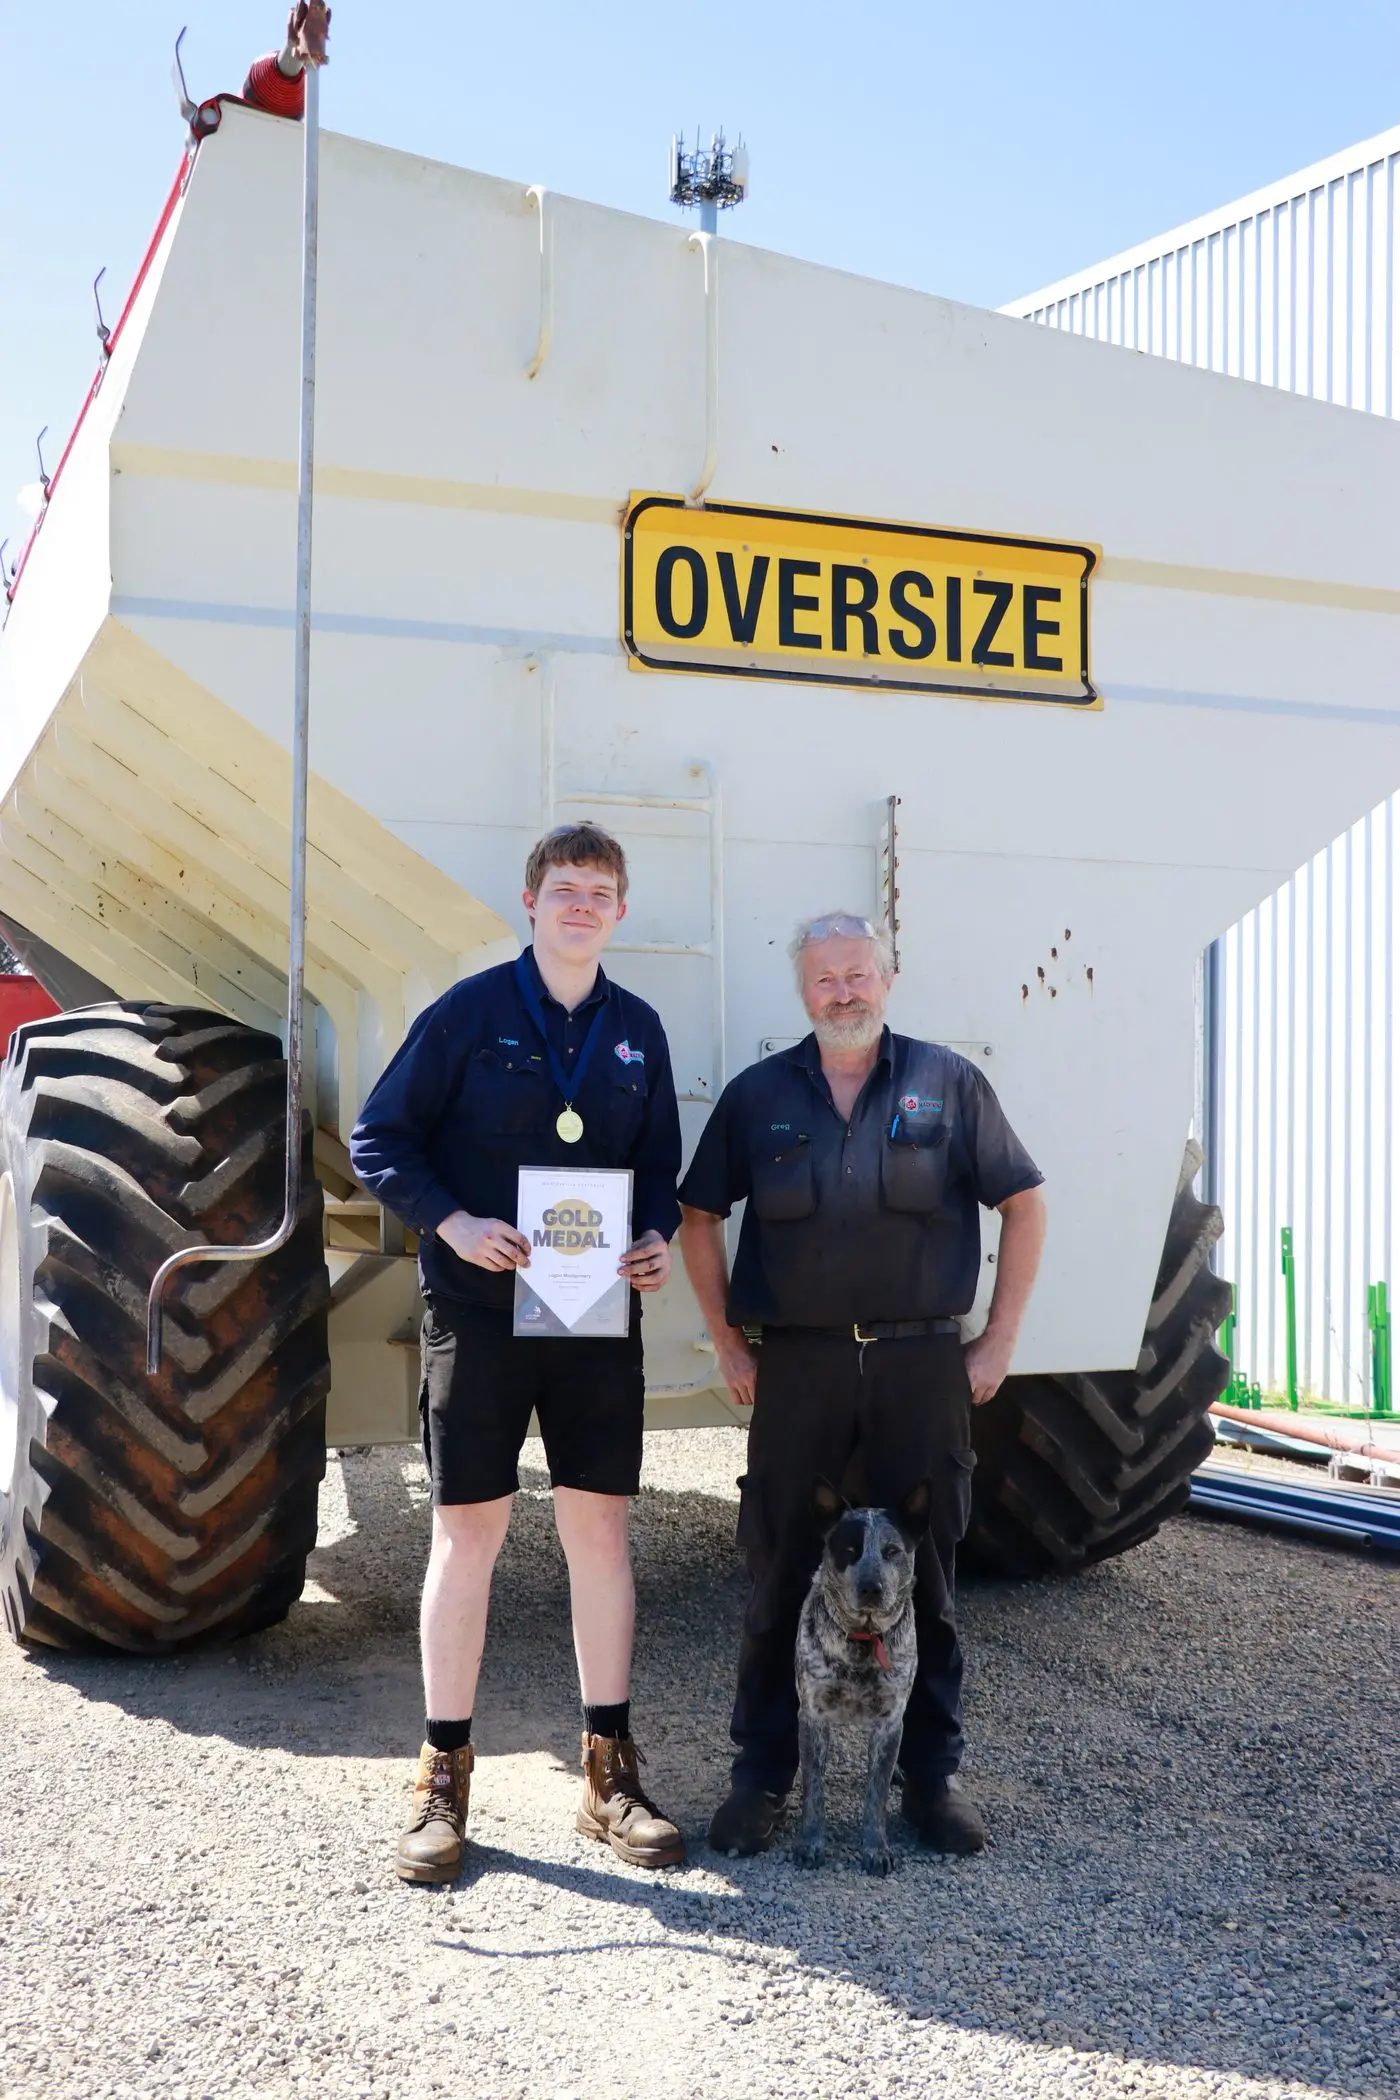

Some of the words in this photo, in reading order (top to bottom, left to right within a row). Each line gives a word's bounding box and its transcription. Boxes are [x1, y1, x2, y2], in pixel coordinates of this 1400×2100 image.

[654, 545, 1063, 672] OVERSIZE
[498, 1036, 519, 1046] Logan
[770, 1123, 790, 1131] Greg
[542, 1208, 603, 1227] GOLD
[532, 1229, 610, 1248] MEDAL
